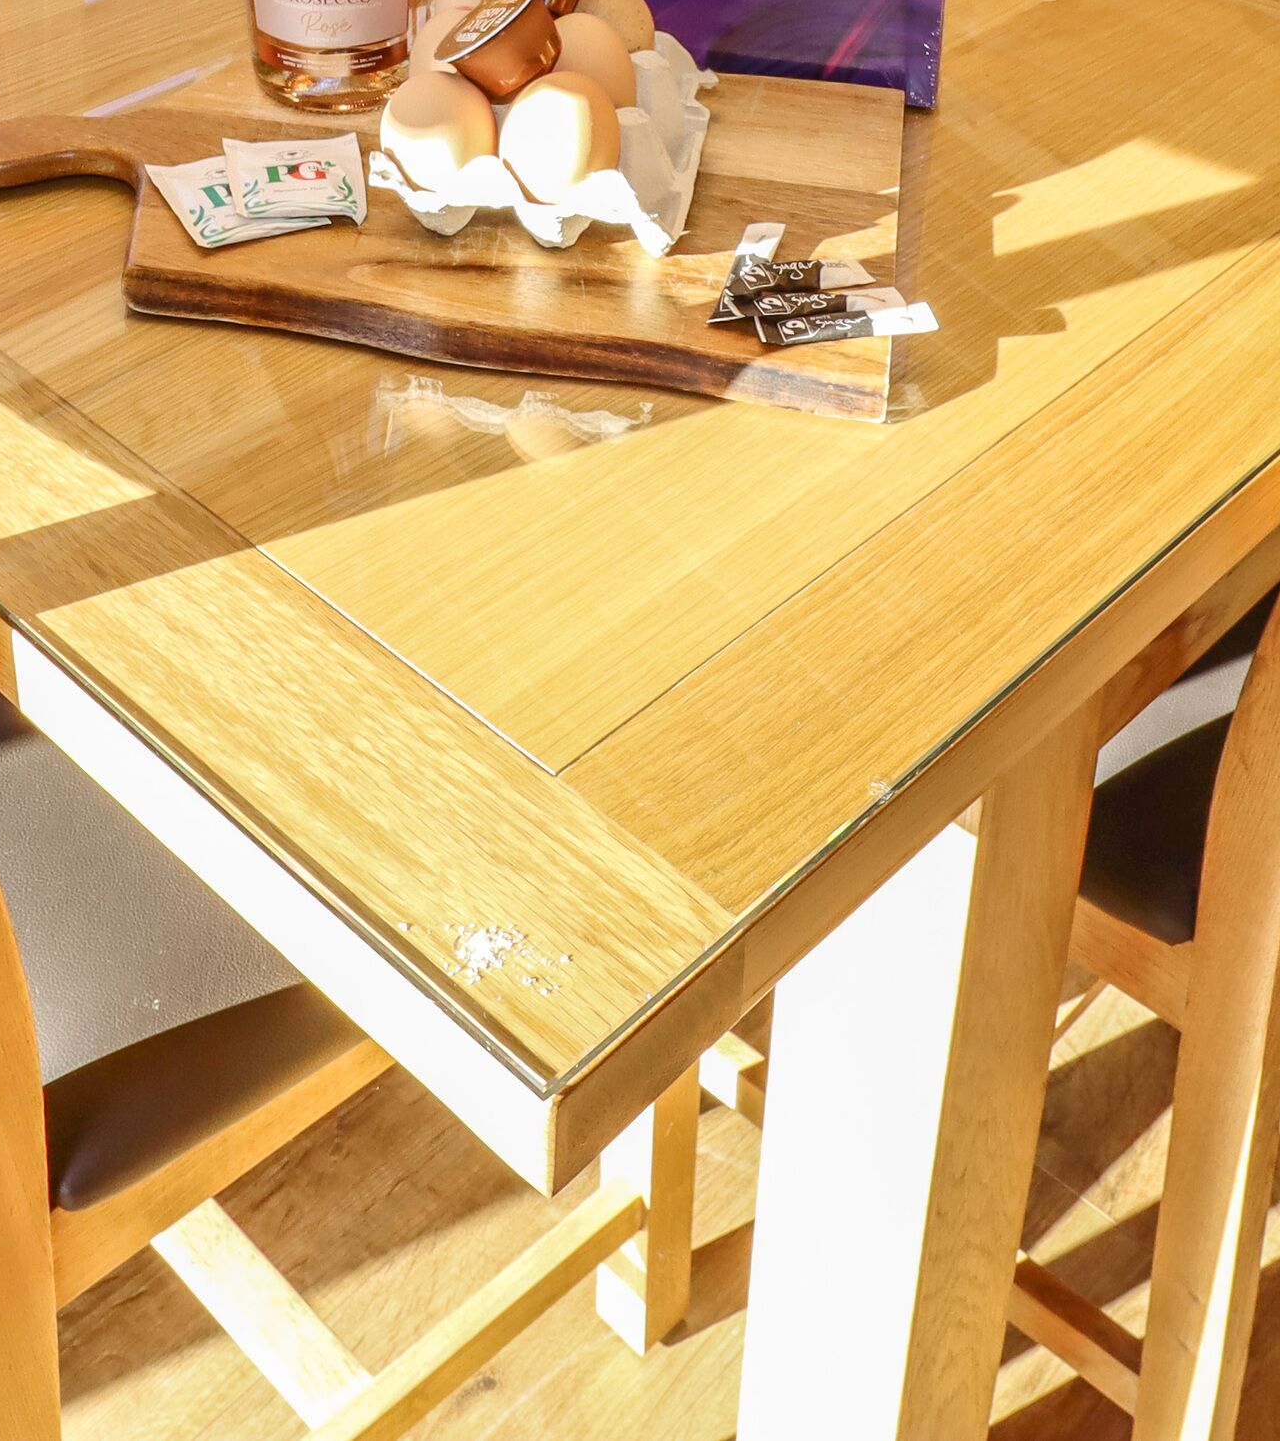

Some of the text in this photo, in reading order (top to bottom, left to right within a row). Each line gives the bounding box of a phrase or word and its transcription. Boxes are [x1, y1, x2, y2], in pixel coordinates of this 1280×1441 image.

[263, 160, 328, 183] PG
[773, 260, 819, 279] sugar
[815, 316, 867, 330] sugar
